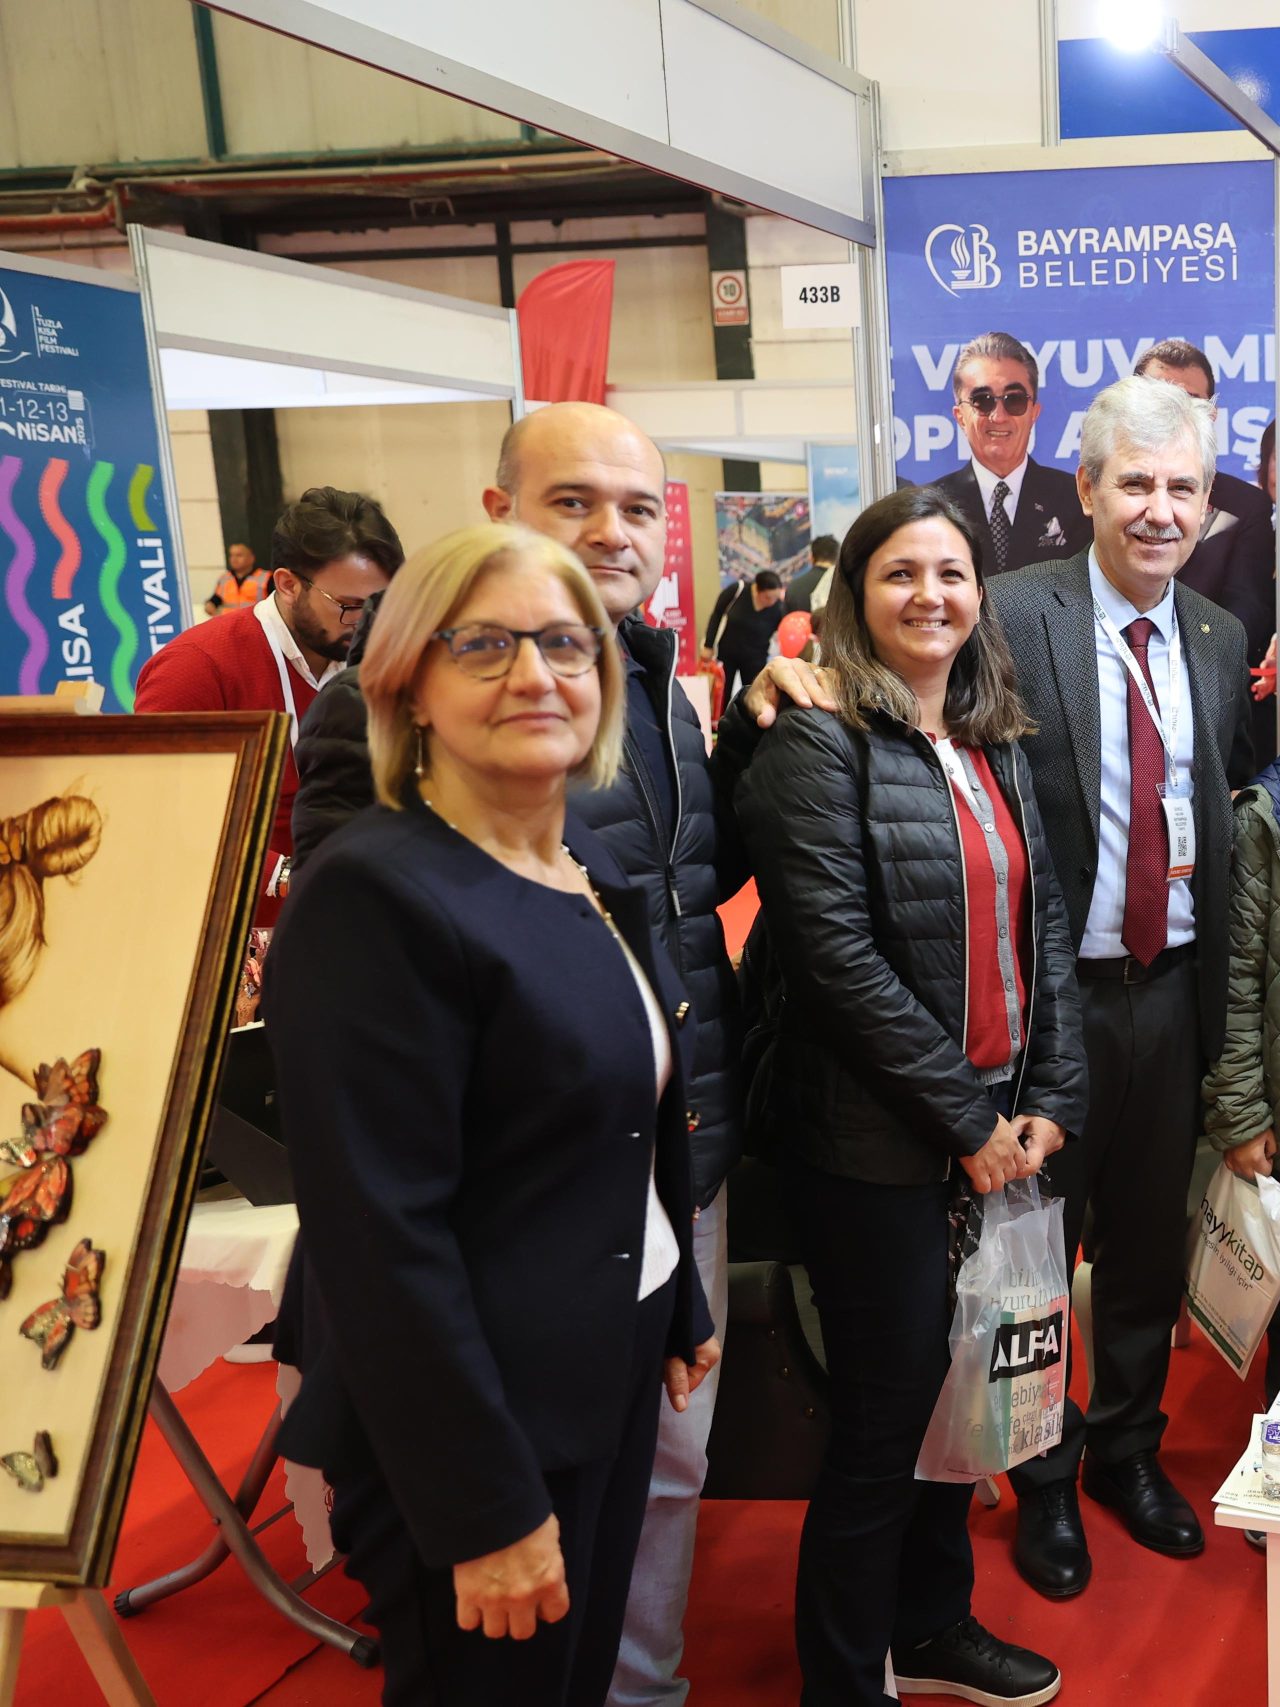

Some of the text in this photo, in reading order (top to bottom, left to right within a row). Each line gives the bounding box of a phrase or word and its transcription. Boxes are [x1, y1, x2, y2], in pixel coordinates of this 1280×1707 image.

[1017, 222, 1237, 256] BAYRAMPAŞA
[1019, 248, 1239, 289] BELEDİYESİ
[799, 286, 841, 304] 433B
[58, 603, 95, 683] ISA
[1200, 1193, 1264, 1281] hayykitap
[992, 1323, 1060, 1372] ALFA
